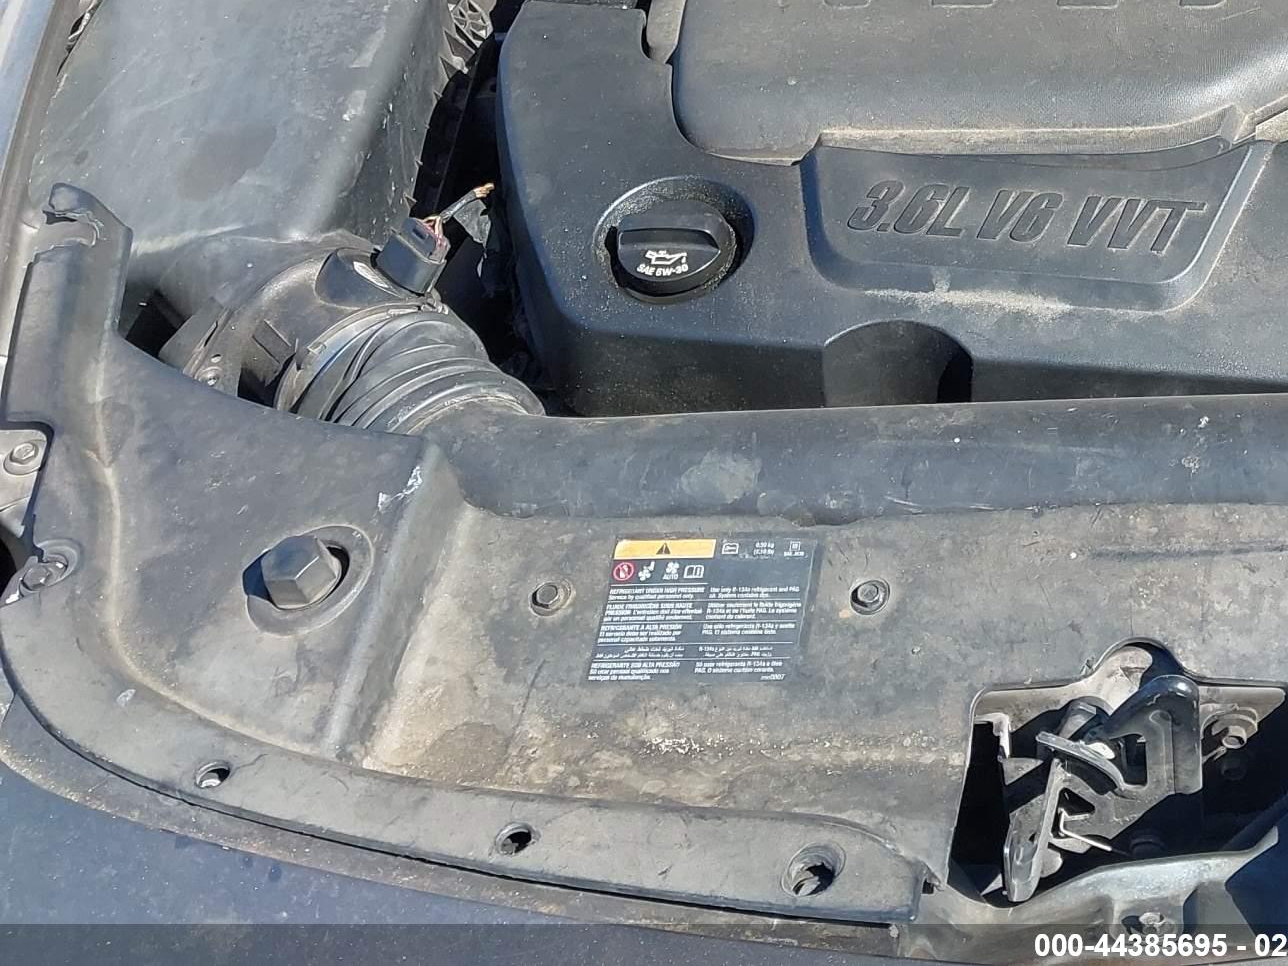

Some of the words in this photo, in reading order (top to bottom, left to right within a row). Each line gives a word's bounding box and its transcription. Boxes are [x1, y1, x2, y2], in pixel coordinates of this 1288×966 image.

[846, 180, 970, 238] 3.6L
[976, 189, 1064, 244] V6
[1066, 195, 1208, 255] VVT
[636, 264, 655, 276] SAE
[655, 264, 689, 277] 5W-30
